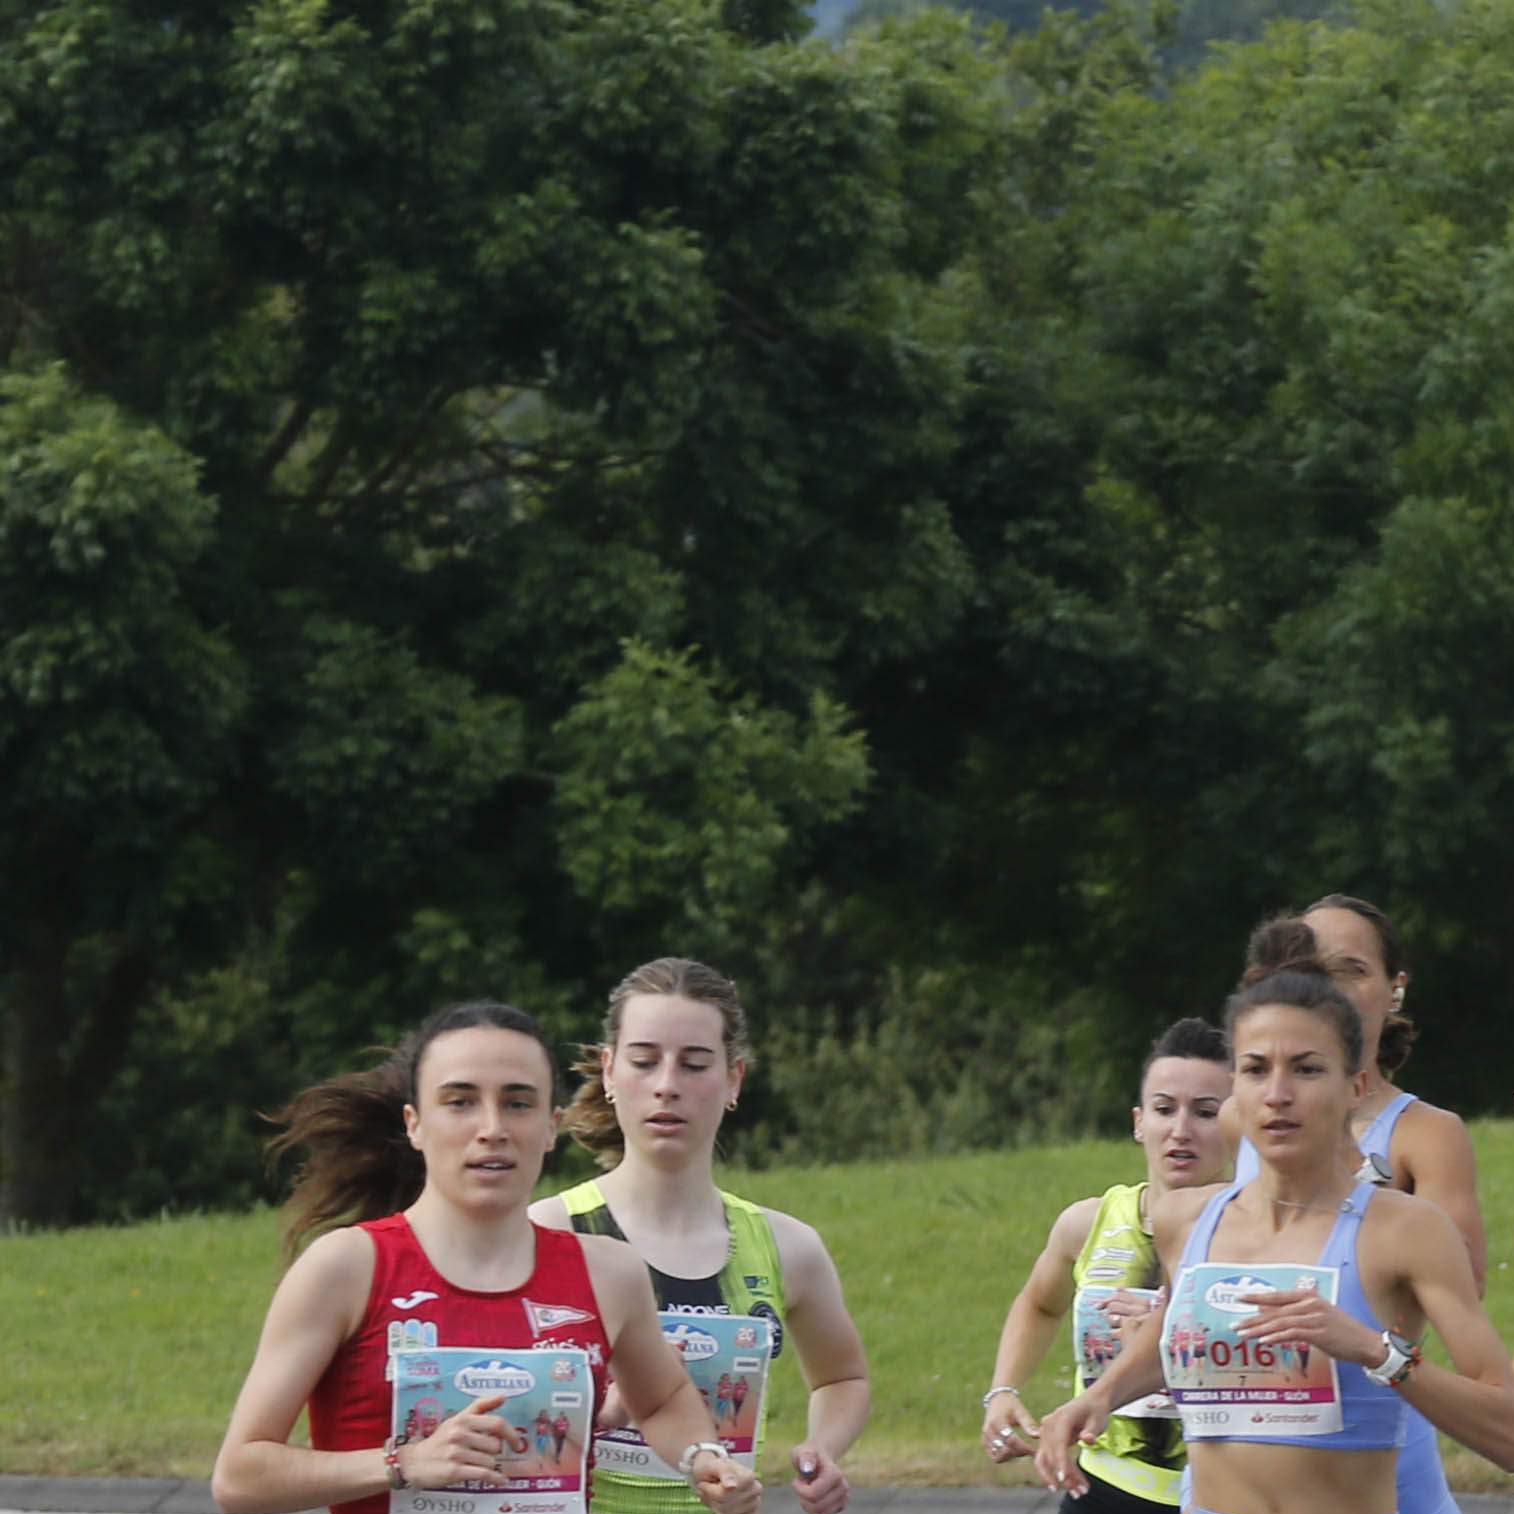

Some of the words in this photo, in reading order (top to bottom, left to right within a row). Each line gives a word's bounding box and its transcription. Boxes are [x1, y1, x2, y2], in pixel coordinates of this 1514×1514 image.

[1209, 1340, 1276, 1367] 016
[458, 1373, 532, 1390] ASTURIANA
[1265, 1412, 1319, 1424] Santander
[594, 1447, 649, 1466] OYSHO
[411, 1496, 476, 1514] OYSHO
[513, 1502, 567, 1514] Santander
